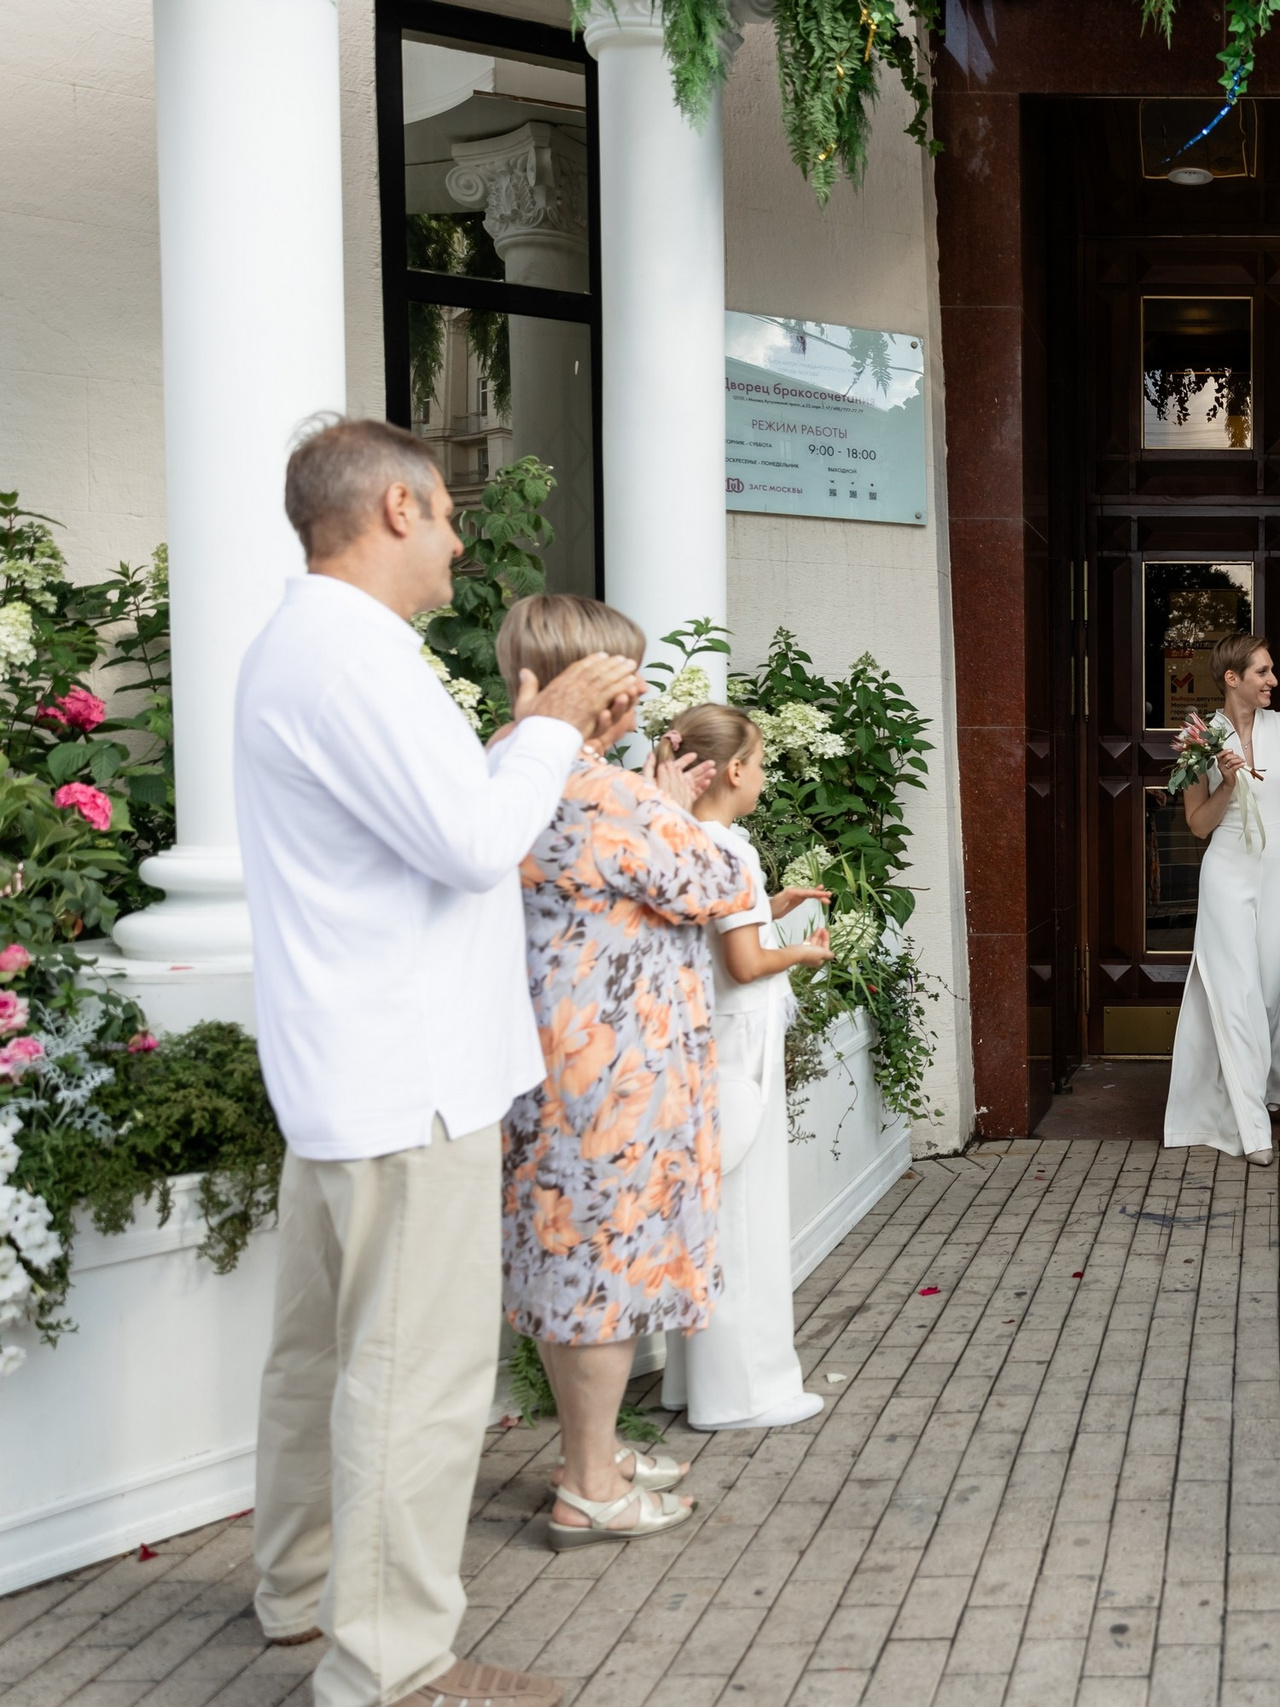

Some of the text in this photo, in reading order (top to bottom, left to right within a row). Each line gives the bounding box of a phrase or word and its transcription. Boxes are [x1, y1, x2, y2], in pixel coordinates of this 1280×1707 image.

[773, 383, 876, 406] бракосочетания
[751, 419, 848, 439] РЕЖИМ РАБОТЫ
[808, 444, 835, 457] 9:00
[846, 447, 877, 461] 18:00
[761, 460, 800, 469] ПОНЕДЕЛЬНИК
[827, 466, 858, 475] ВЫХОДНОЙ
[749, 483, 803, 494] ЗАГС МОСКВЫ
